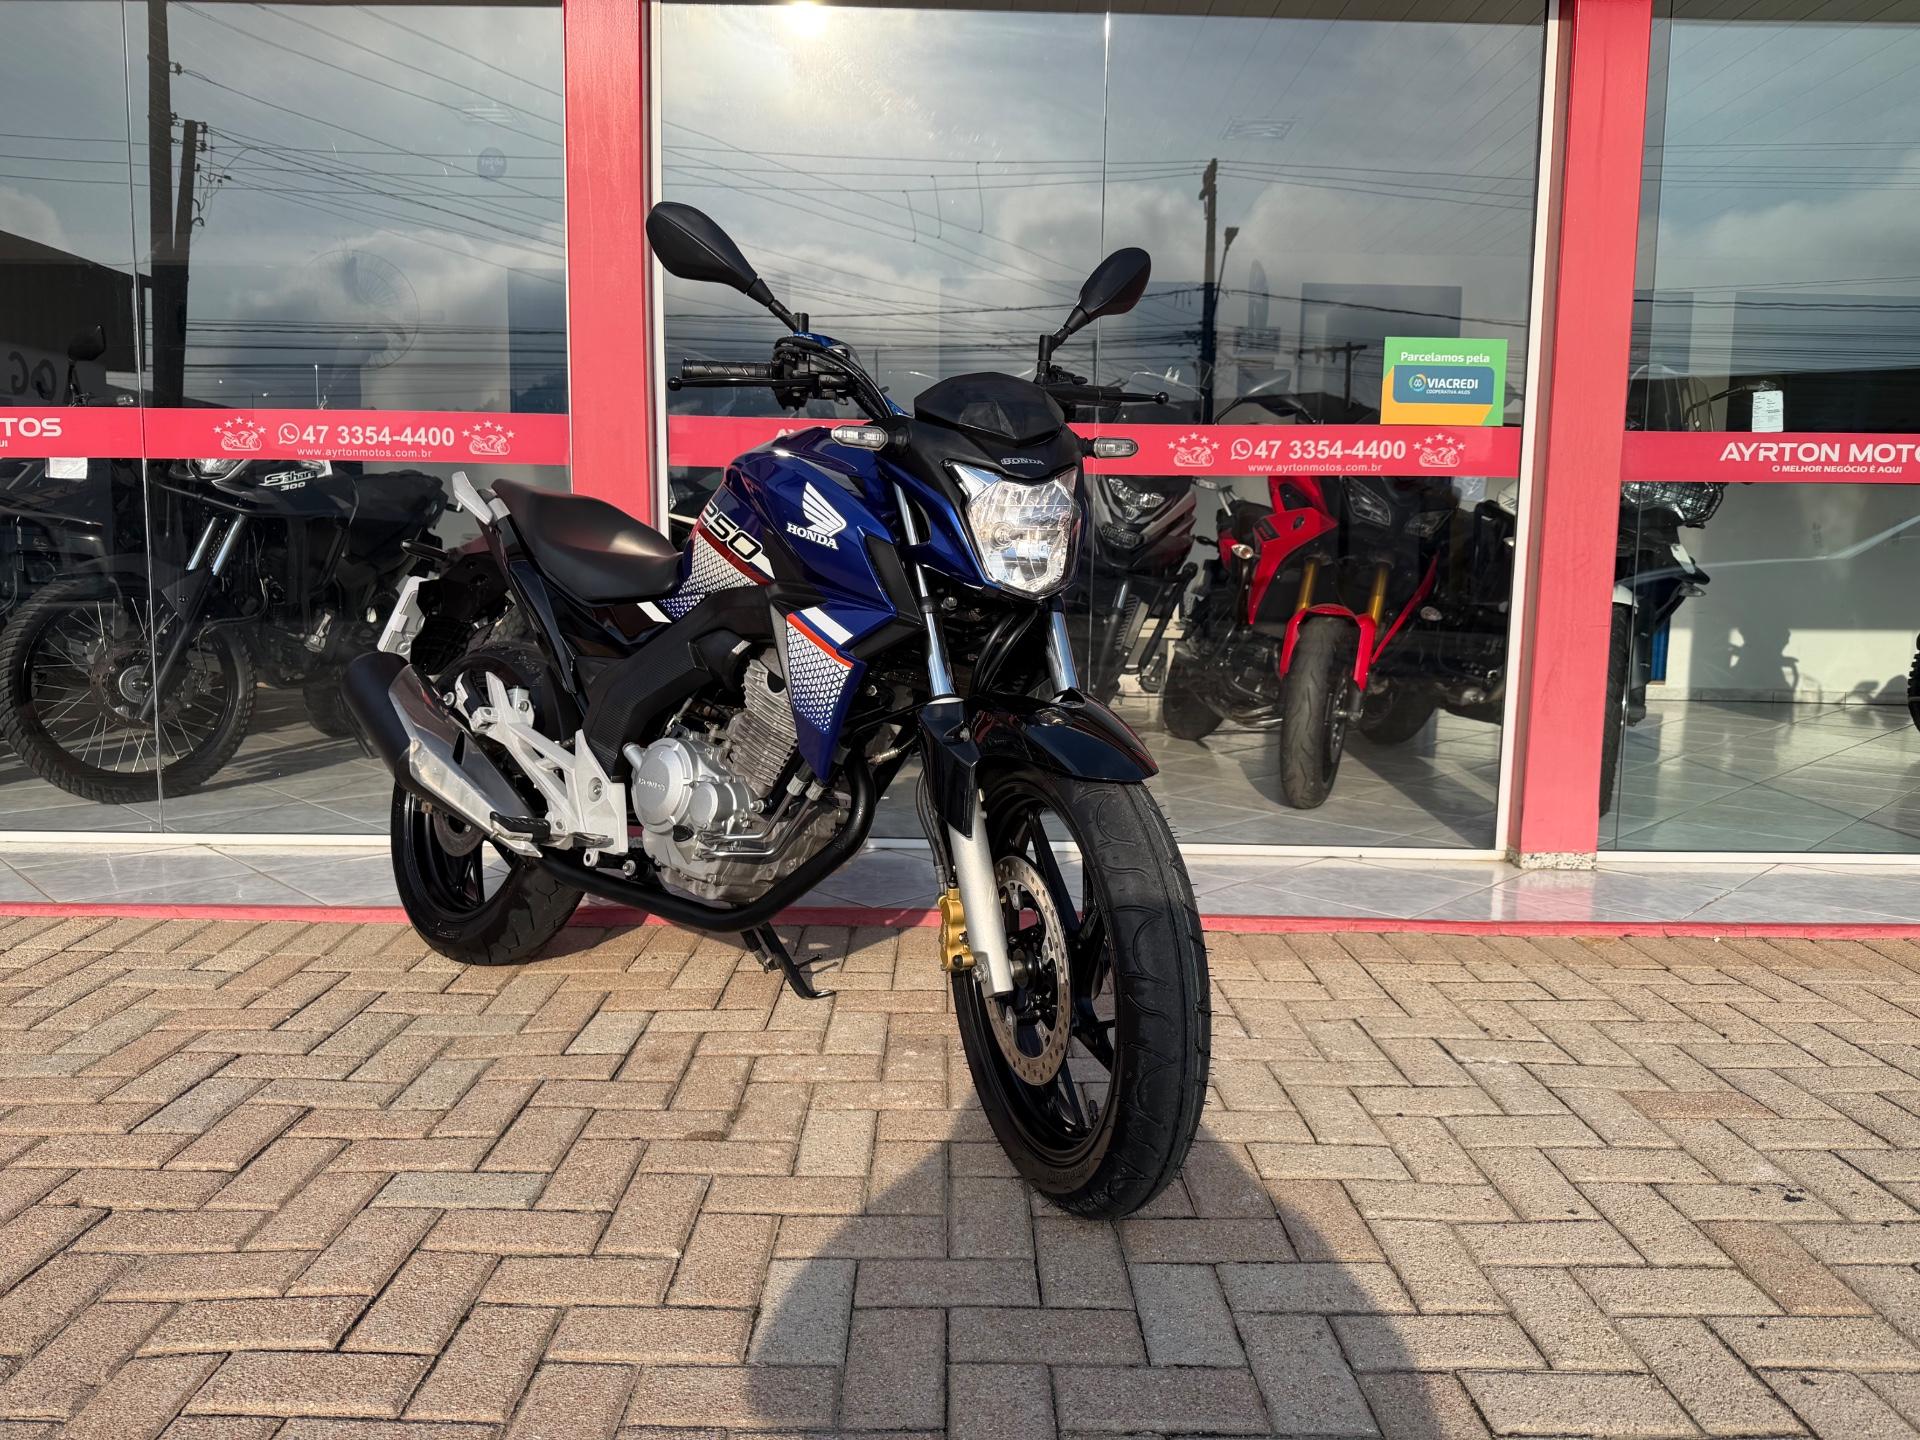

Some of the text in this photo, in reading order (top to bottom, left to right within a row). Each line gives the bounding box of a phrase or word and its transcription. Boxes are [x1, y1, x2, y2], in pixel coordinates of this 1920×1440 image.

[1400, 351, 1490, 365] Parcelamos pela
[1427, 378, 1479, 389] VIACREDI
[302, 425, 455, 446] 47 3354-4400
[297, 447, 432, 458] www.ayrtonmotos.com.br
[1254, 440, 1406, 460] 47 3354-4400
[1719, 442, 1920, 463] AYRTON MOT
[1000, 457, 1046, 465] HONDA
[1248, 463, 1382, 474] www.ayrtonmotos.com.br
[1772, 465, 1781, 473] O
[1781, 465, 1823, 473] MELHOR
[1823, 464, 1868, 473] NEGÓCIO
[1877, 465, 1903, 474] AQUI
[280, 481, 306, 492] 300
[786, 522, 840, 550] HONDA
